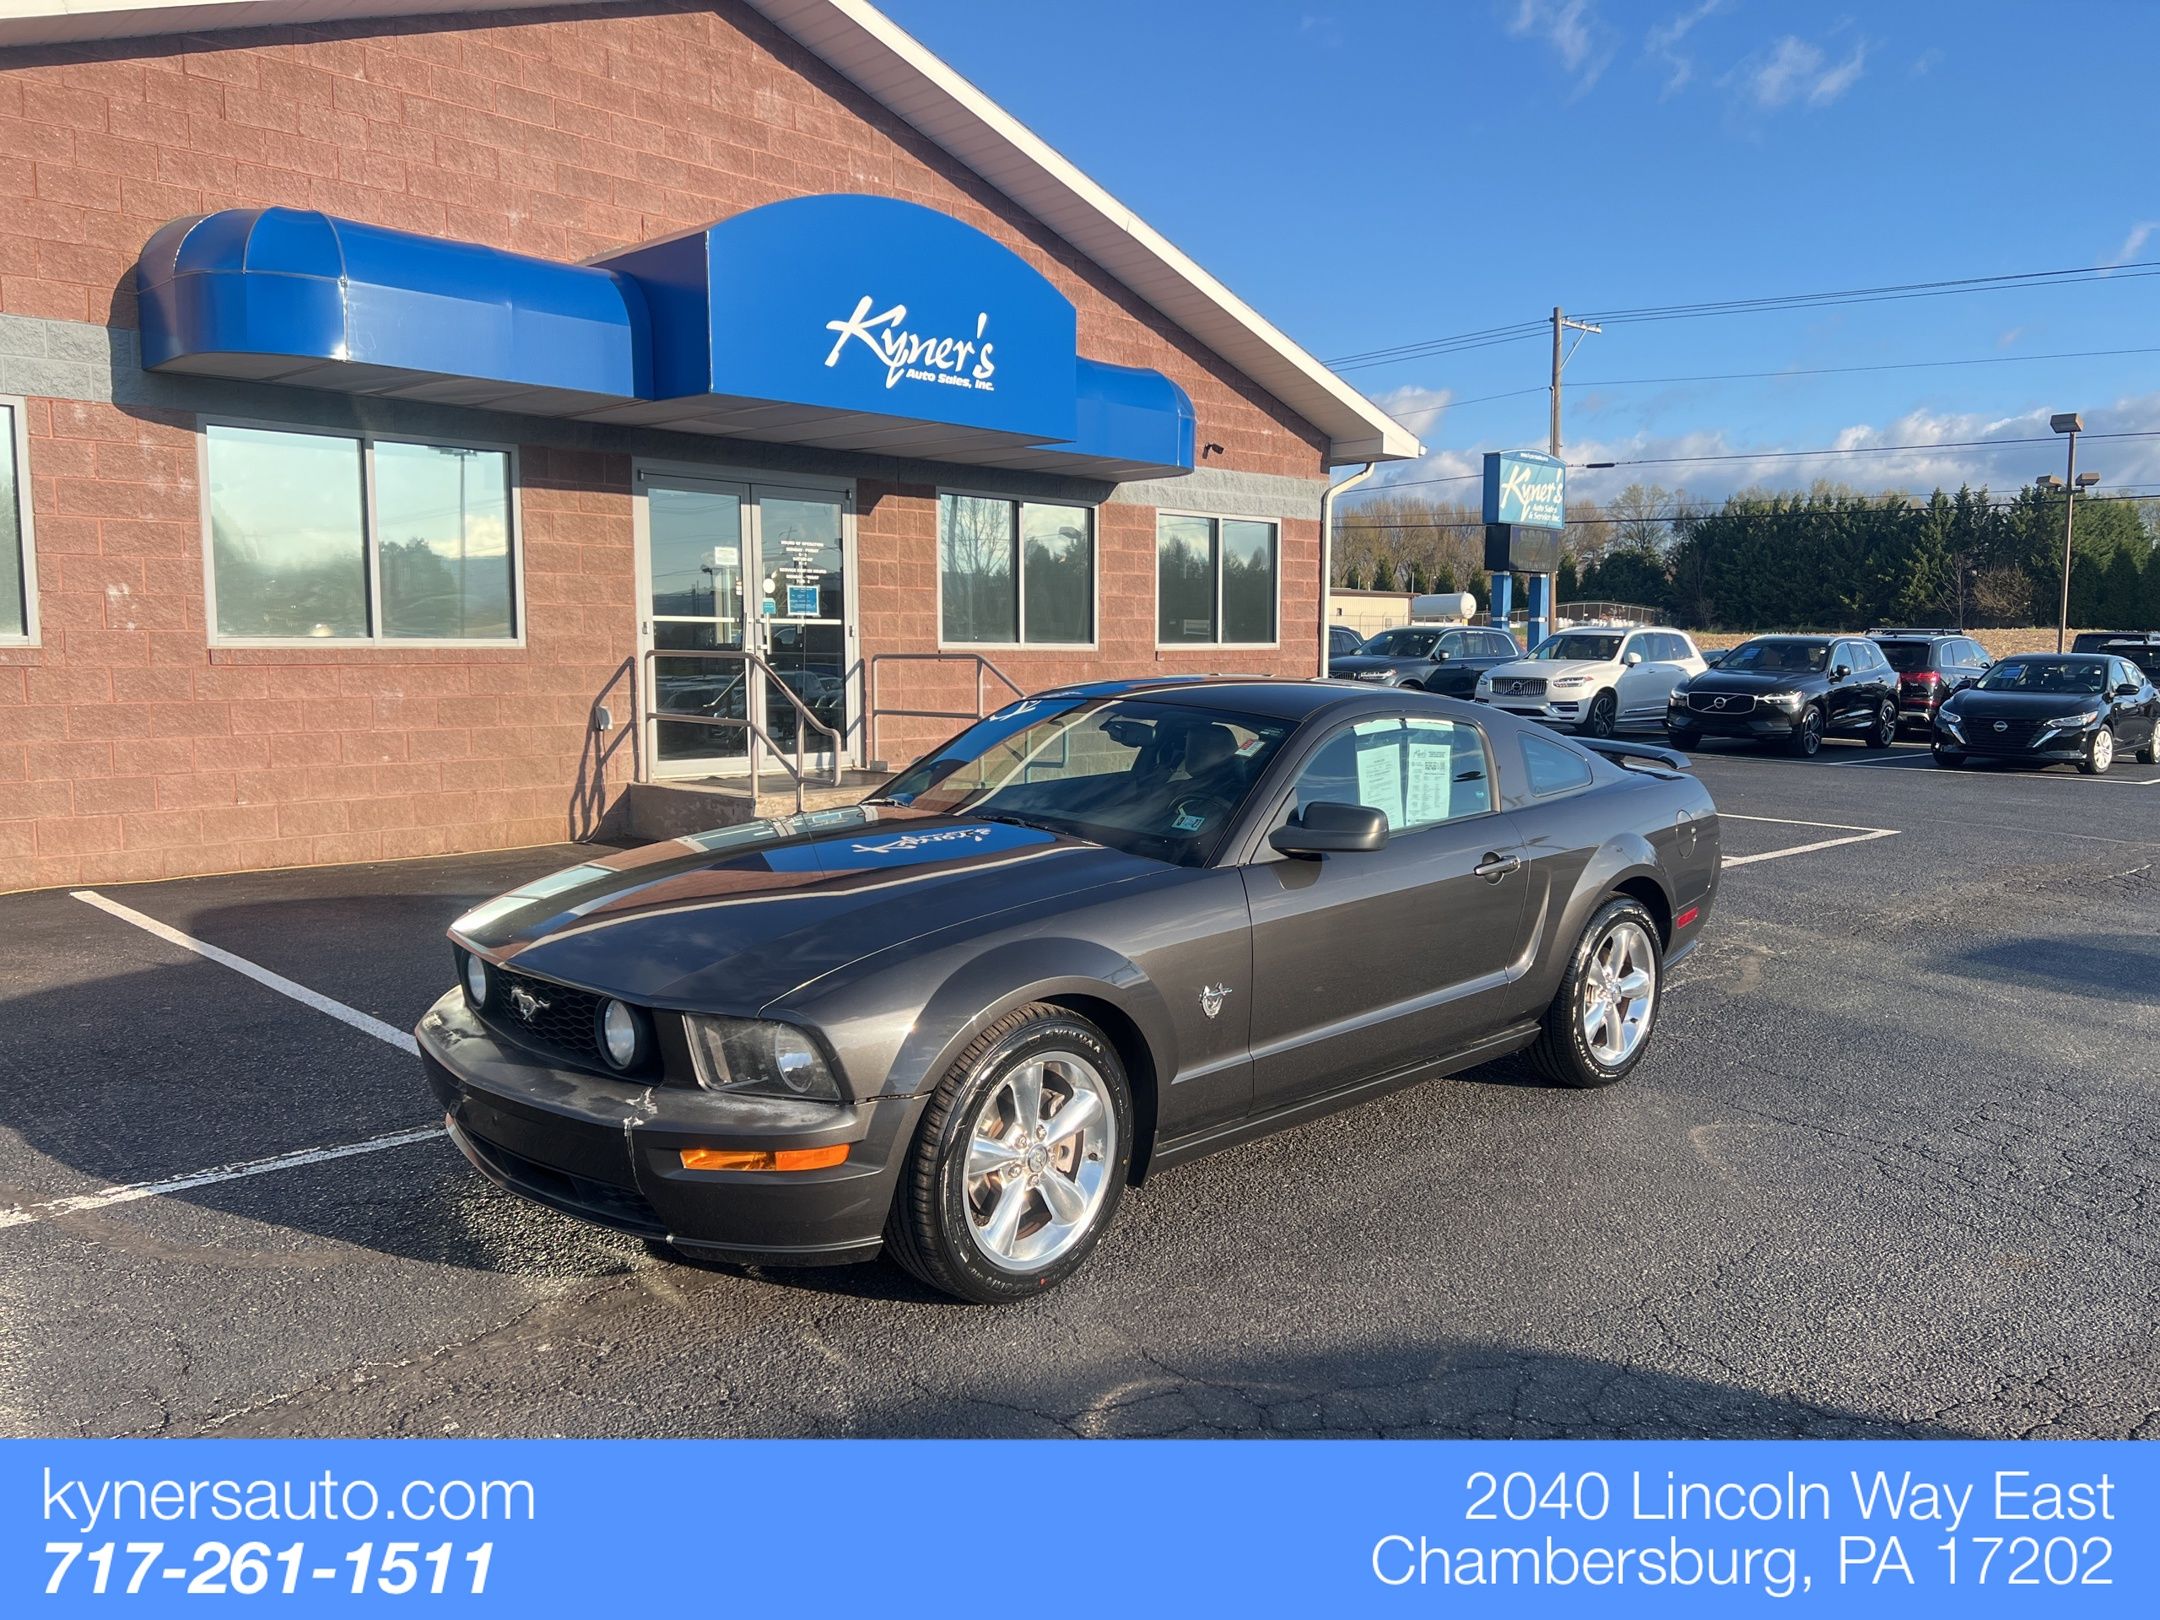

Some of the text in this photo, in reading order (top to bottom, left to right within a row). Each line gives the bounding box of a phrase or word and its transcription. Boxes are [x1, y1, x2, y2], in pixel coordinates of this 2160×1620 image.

[825, 295, 995, 389] Kyner's
[906, 368, 995, 391] Auto Sales, Inc.
[1500, 465, 1563, 522] Kyner's
